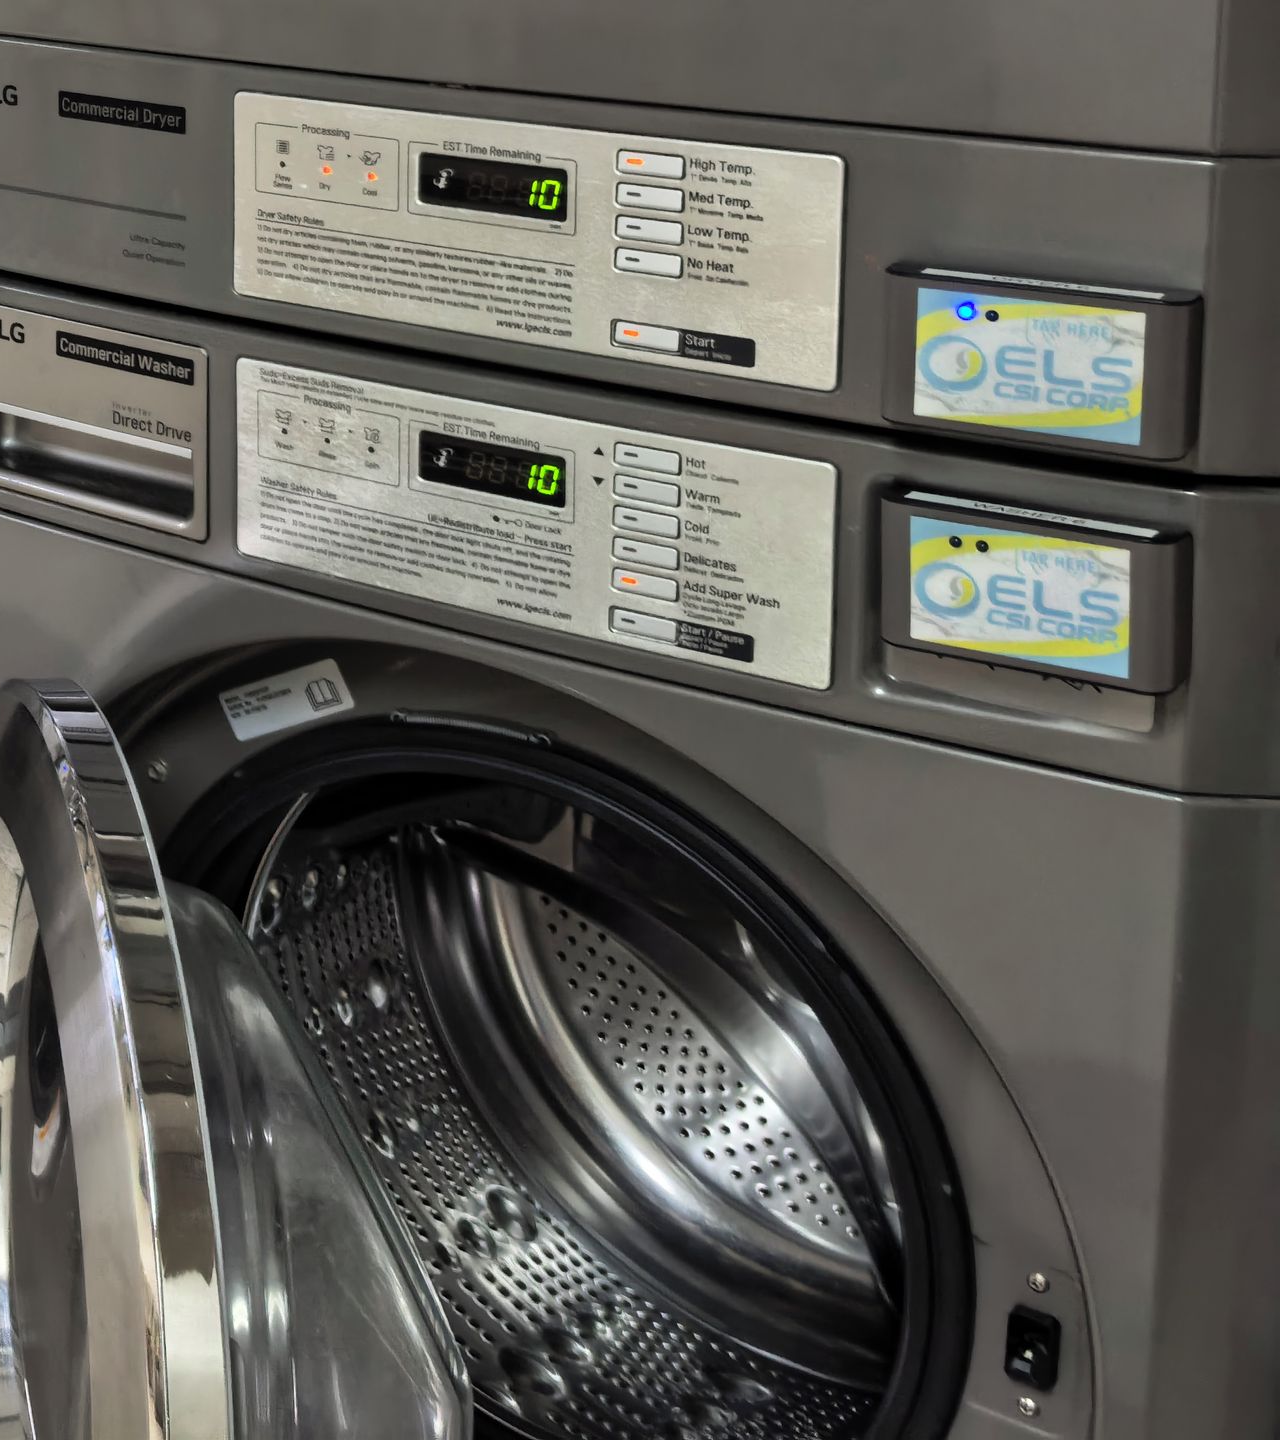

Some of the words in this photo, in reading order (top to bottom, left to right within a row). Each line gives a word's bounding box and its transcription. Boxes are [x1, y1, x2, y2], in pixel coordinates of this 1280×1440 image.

[62, 97, 139, 122] Commercial
[143, 108, 182, 129] Dryer
[301, 124, 350, 140] Processing
[464, 144, 487, 155] Time
[489, 145, 541, 163] Remaining
[690, 158, 716, 174] High
[719, 160, 756, 176] Temp.
[529, 179, 561, 210] 10
[689, 192, 714, 205] Med
[718, 194, 754, 210] Temp.
[688, 224, 713, 238] Low
[716, 227, 753, 244] Temp.
[687, 258, 703, 270] No
[706, 260, 734, 274] Heat
[685, 334, 716, 348] Start
[60, 337, 135, 367] Commercial
[138, 354, 192, 380] Washer
[995, 345, 1133, 394] ELS
[303, 395, 352, 413] Processing
[994, 382, 1039, 403] CSI
[1046, 388, 1130, 413] CORP
[112, 410, 152, 434] Direct
[156, 421, 192, 442] Drive
[464, 426, 487, 439] Time
[489, 430, 540, 451] Remaining
[686, 457, 706, 470] Hot
[260, 476, 288, 490] Washer
[290, 482, 315, 496] Safety
[316, 488, 338, 500] Rules
[528, 464, 560, 496] 10
[685, 488, 721, 504] Warm
[684, 520, 710, 536] Cold
[684, 552, 737, 572] Delicates
[684, 580, 706, 596] Add
[709, 586, 744, 602] Super
[746, 594, 781, 610] Wash
[987, 574, 1120, 628] ELS
[680, 624, 707, 639] Start
[987, 611, 1030, 630] CSI
[1038, 620, 1118, 643] CORP
